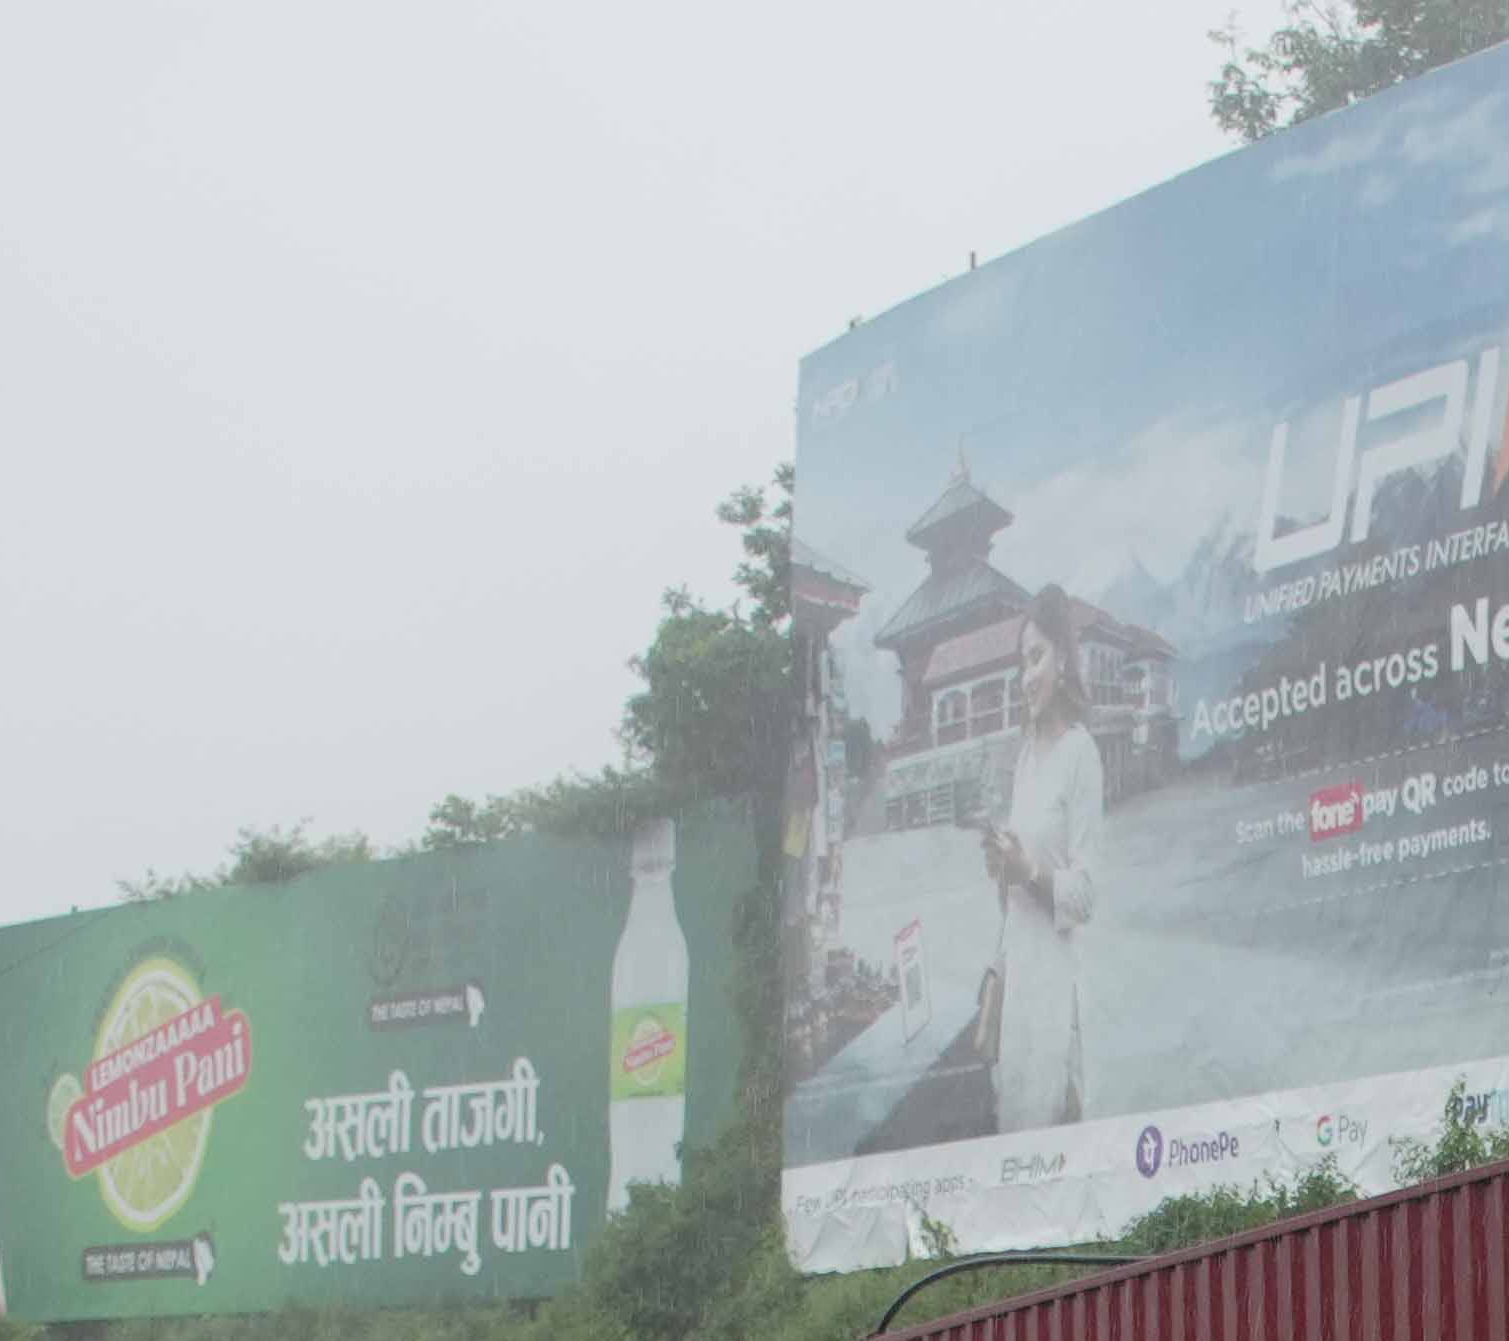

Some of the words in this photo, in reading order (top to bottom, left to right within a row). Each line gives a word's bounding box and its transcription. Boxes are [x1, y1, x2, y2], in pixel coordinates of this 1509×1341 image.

[1243, 577, 1319, 625] UNIFIED
[1316, 545, 1423, 603] PAYMENTS
[1190, 663, 1327, 740] Accepted
[1335, 643, 1439, 700] across
[1235, 818, 1274, 845] Scan
[1276, 810, 1306, 834] the
[1401, 772, 1437, 814] QR
[1443, 766, 1489, 798] code
[1301, 841, 1393, 880] hassle-free
[1398, 817, 1492, 865] payments.
[73, 1078, 169, 1163] Nimbu
[173, 1020, 246, 1109] Pani
[303, 1068, 415, 1162] असली
[1167, 1131, 1240, 1170] PhonePe
[1337, 1114, 1368, 1151] Pay
[277, 1177, 386, 1267] असली
[393, 1171, 482, 1275] निम्बु
[490, 1162, 575, 1253] पानी
